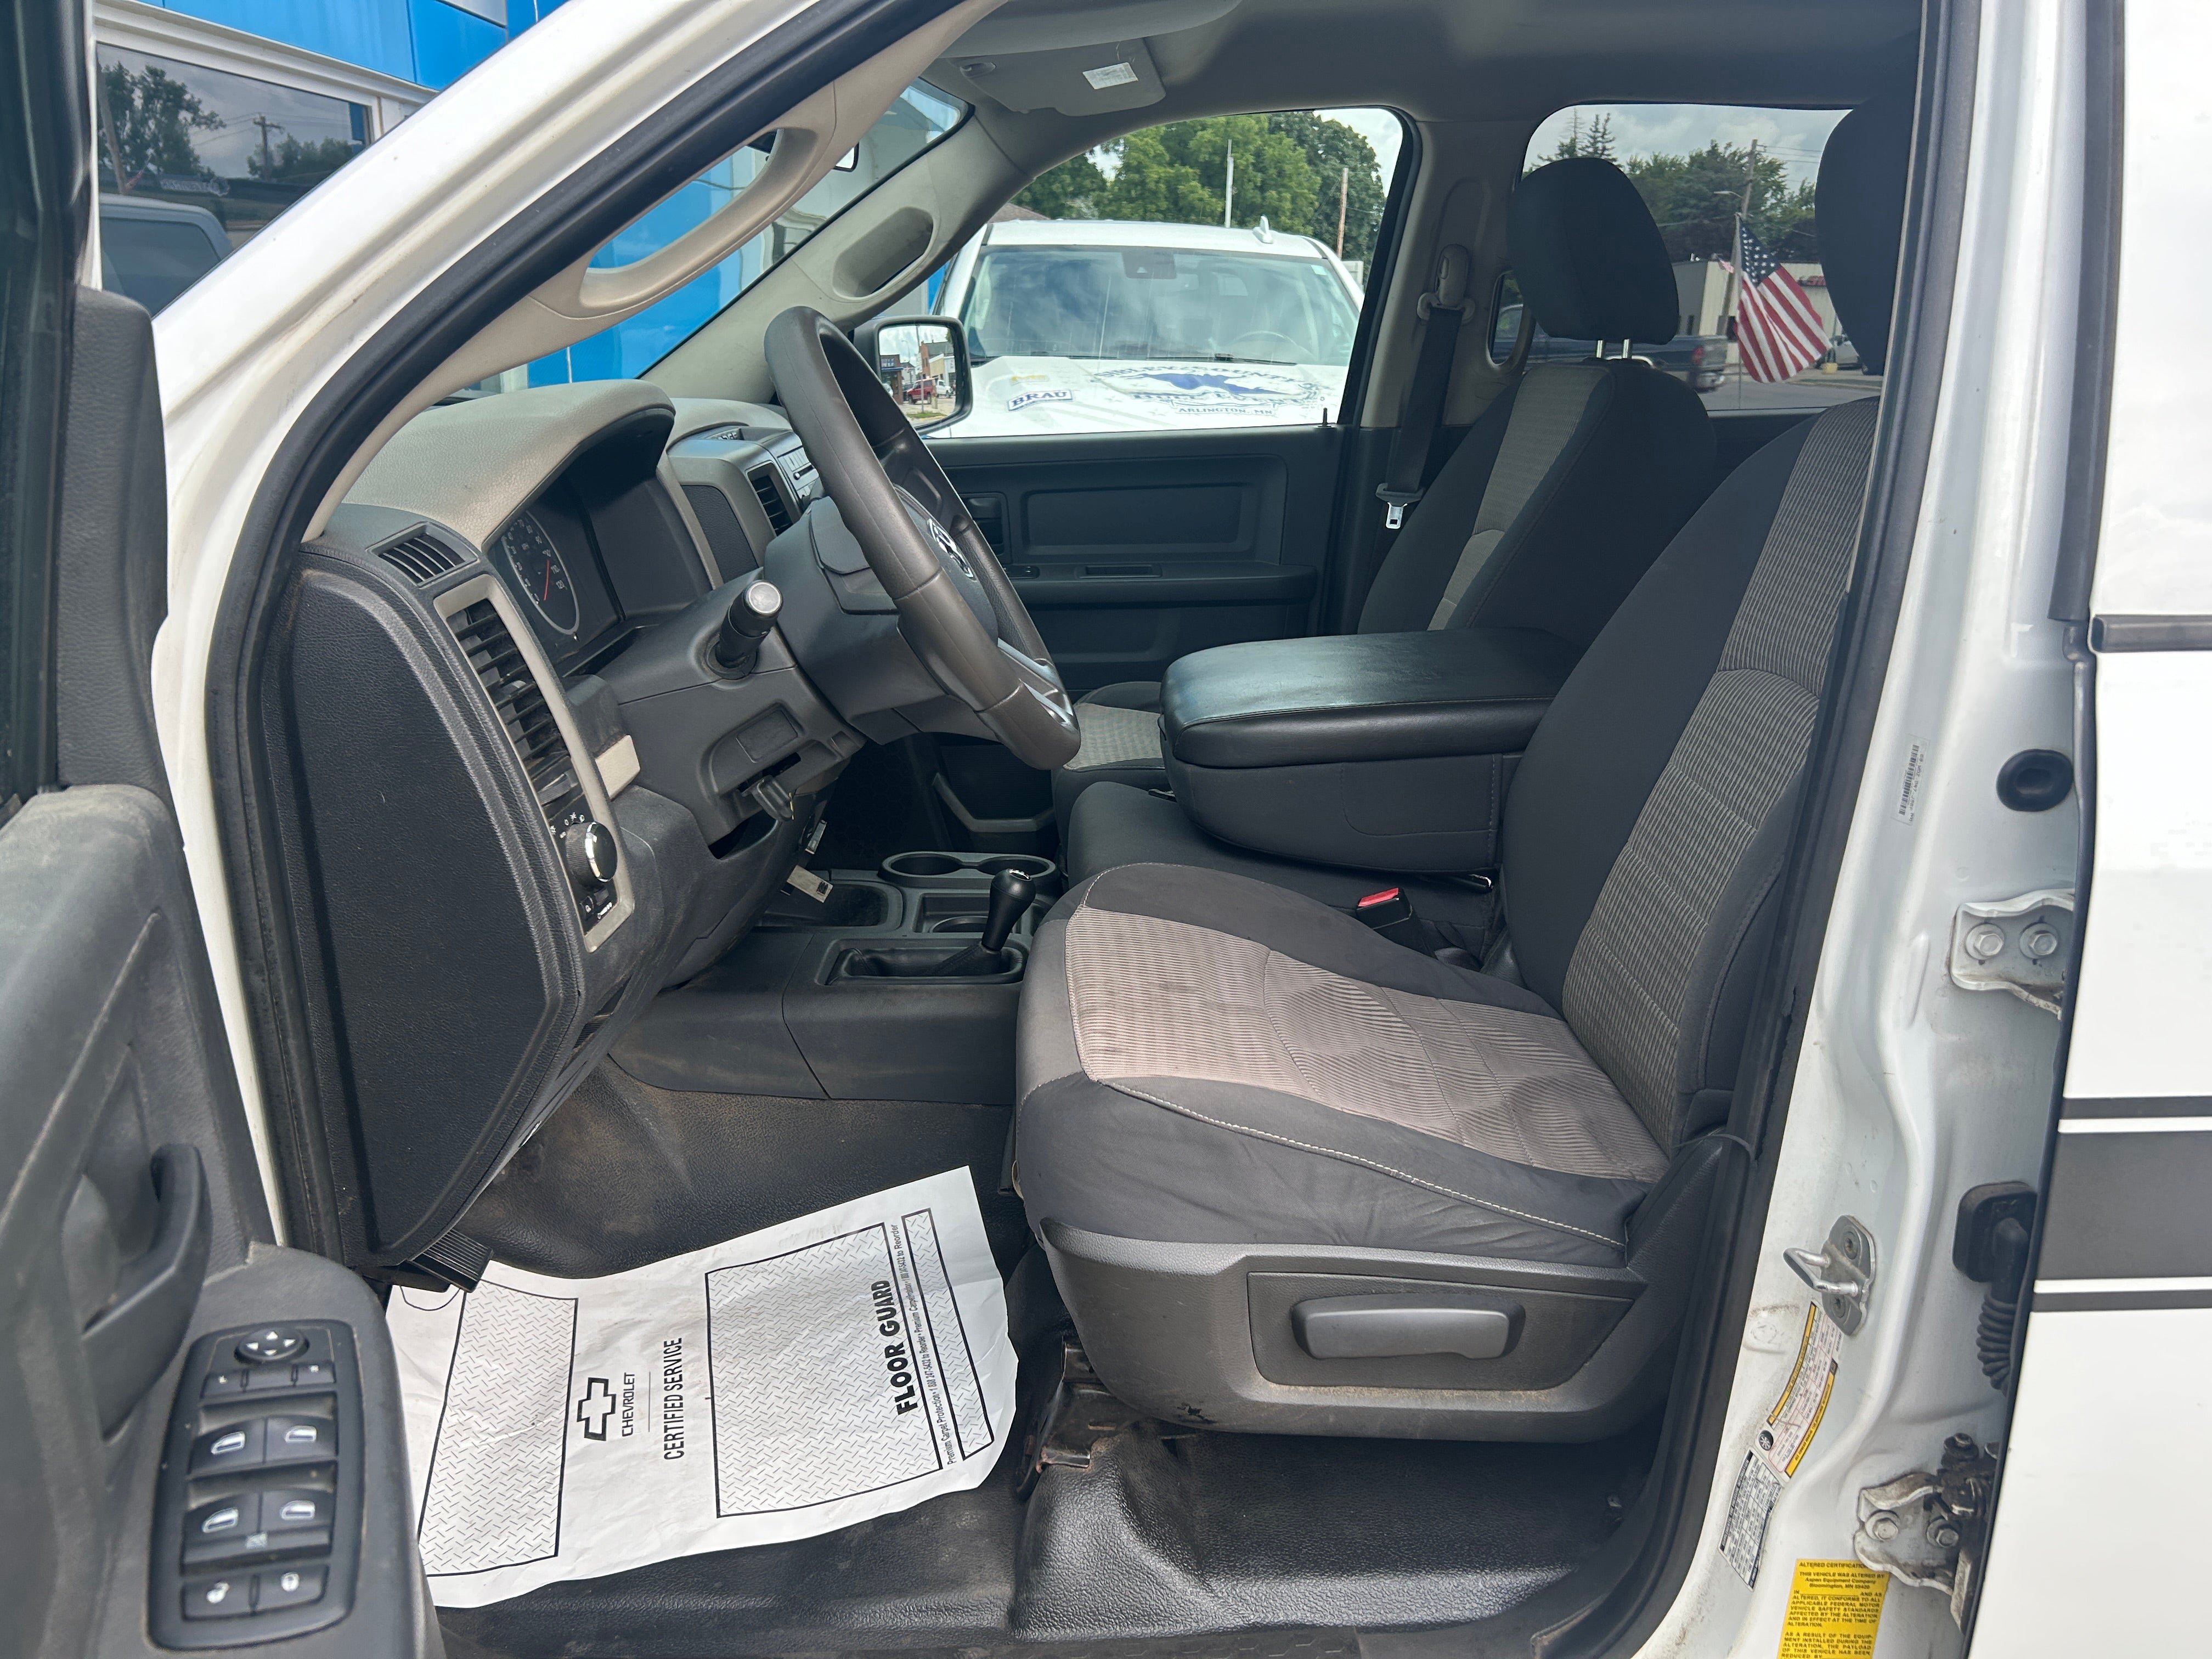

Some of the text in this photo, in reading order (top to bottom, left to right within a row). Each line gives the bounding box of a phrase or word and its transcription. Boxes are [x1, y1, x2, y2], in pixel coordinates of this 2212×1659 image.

[1012, 391, 1067, 407] BRAU
[891, 1224, 902, 1249] Reorder
[912, 1312, 923, 1333] Premium
[871, 1280, 918, 1415] FLOOR GUARD
[918, 1338, 928, 1353] Reorder
[922, 1361, 935, 1380] 247-5432
[622, 1372, 635, 1437] CHEVROLET
[663, 1338, 685, 1460] CERTIFIED SERVICE
[941, 1424, 952, 1441] Carpet
[944, 1440, 957, 1465] Premium
